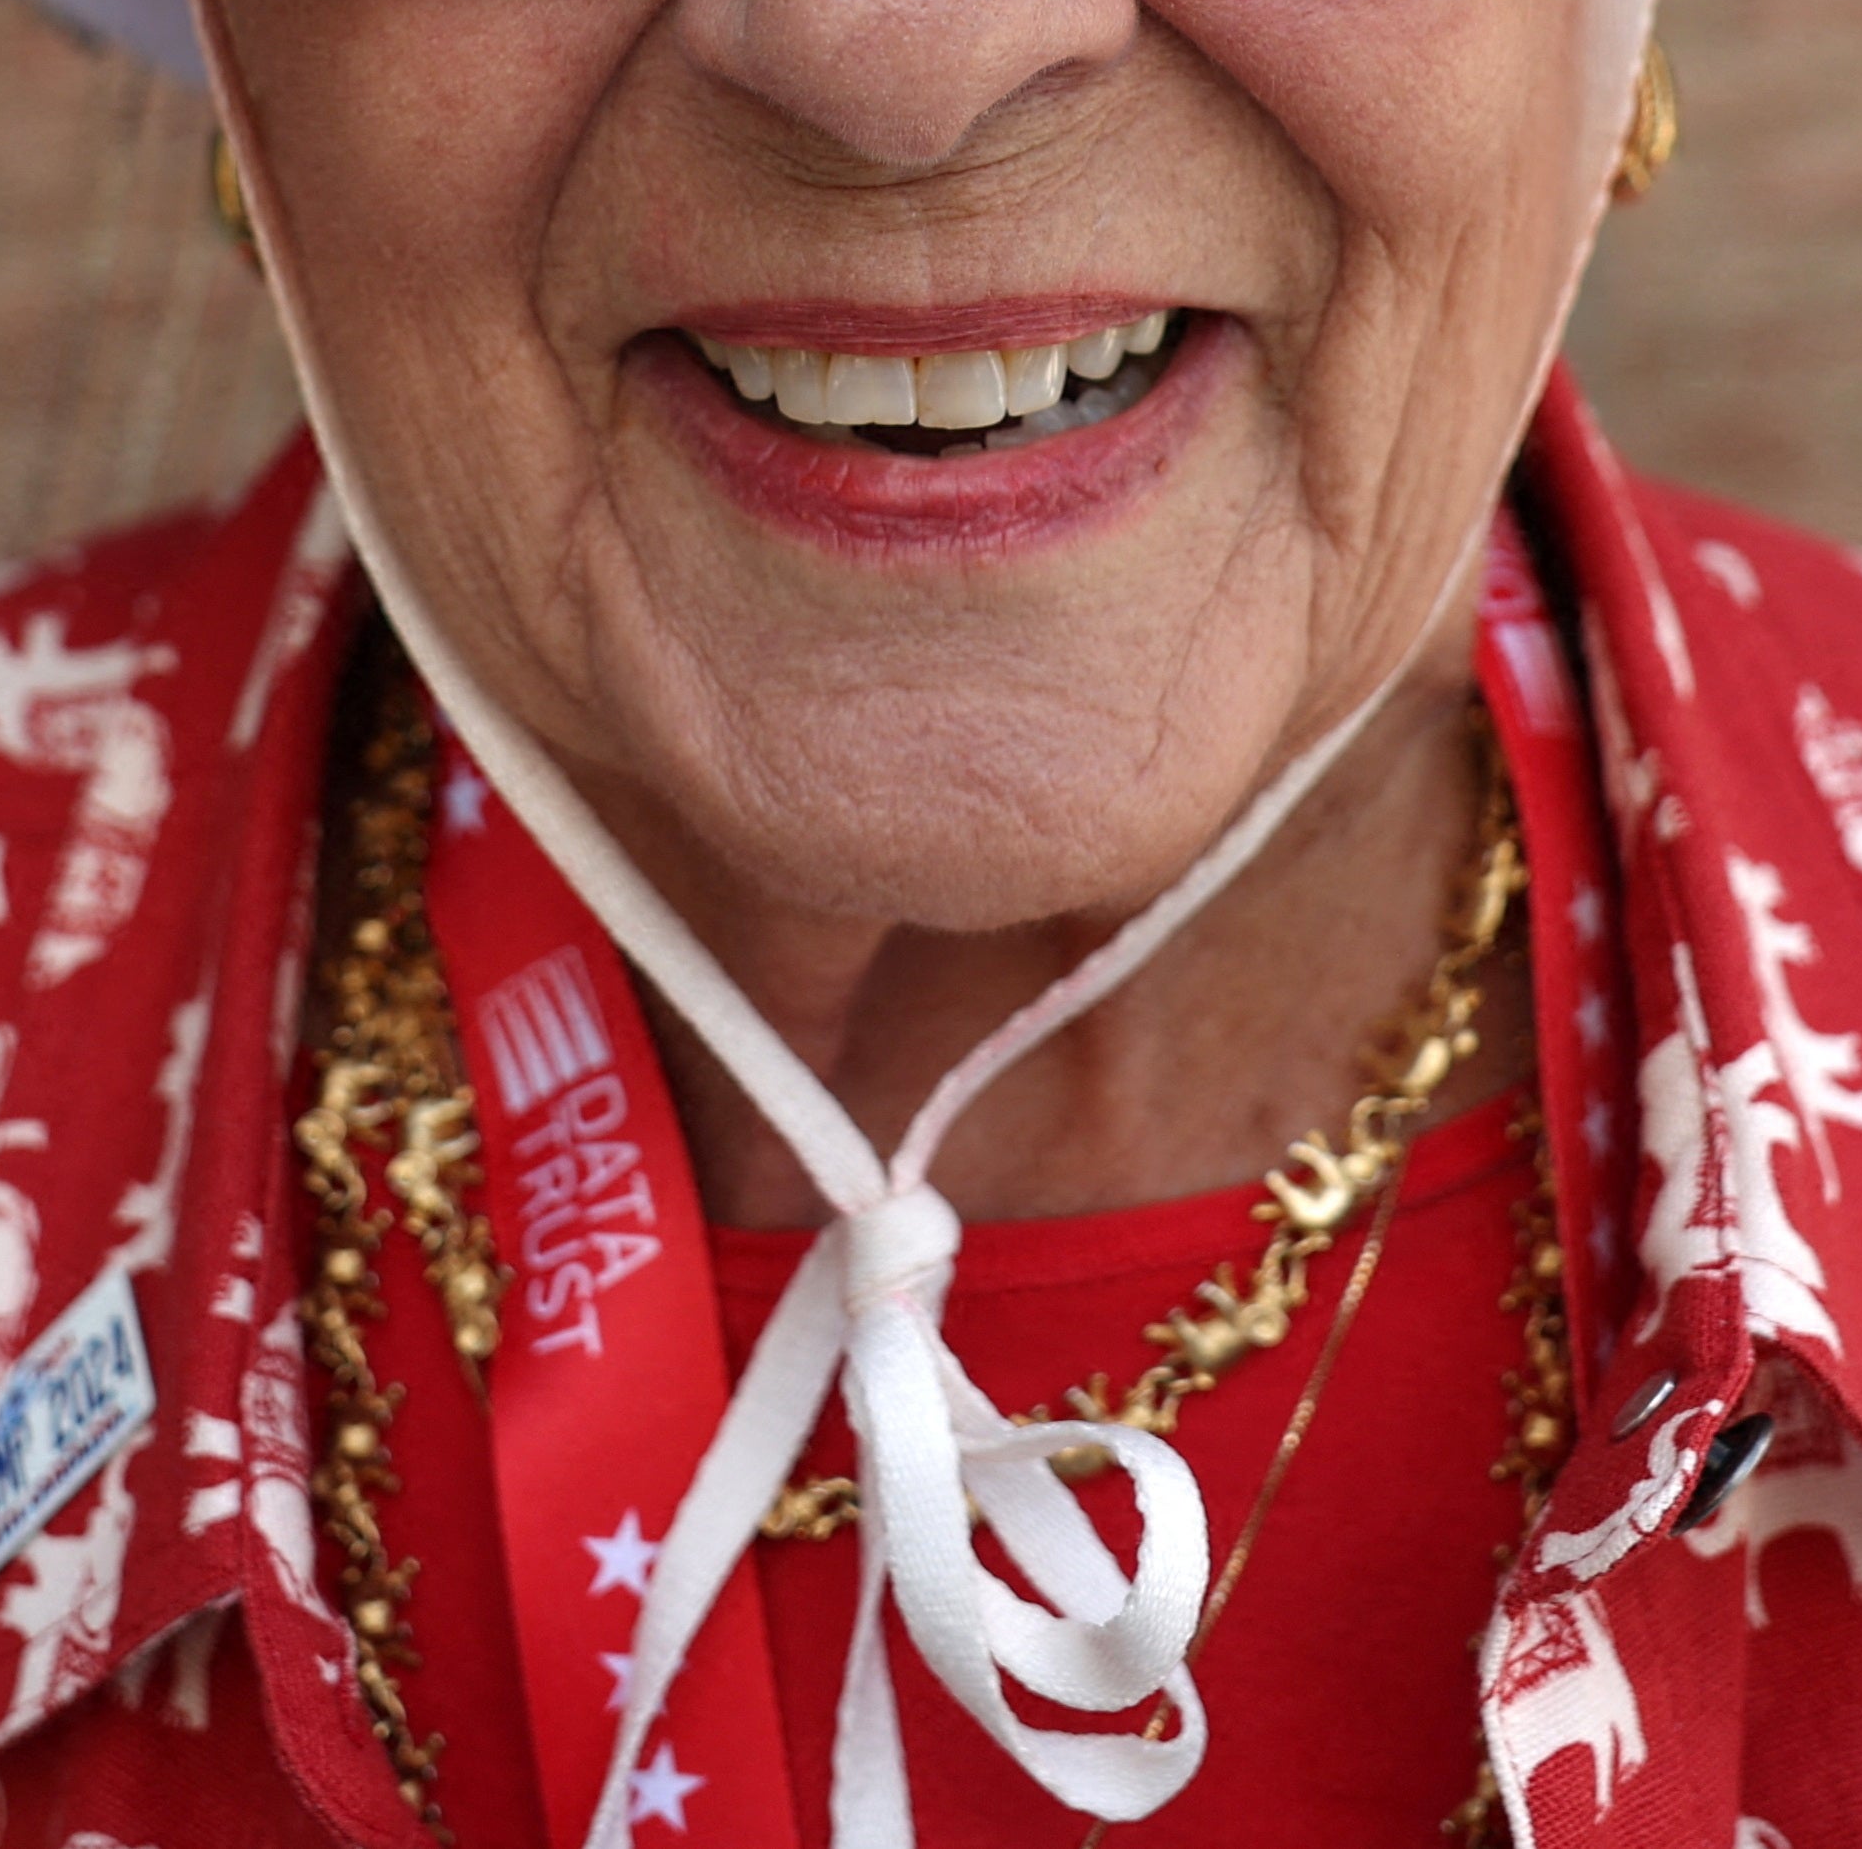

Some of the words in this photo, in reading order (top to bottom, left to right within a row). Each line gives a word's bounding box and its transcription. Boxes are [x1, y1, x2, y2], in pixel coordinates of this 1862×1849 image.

[512, 1101, 604, 1357] TRUST
[563, 1072, 663, 1292] DATA
[46, 1313, 135, 1450] 2024
